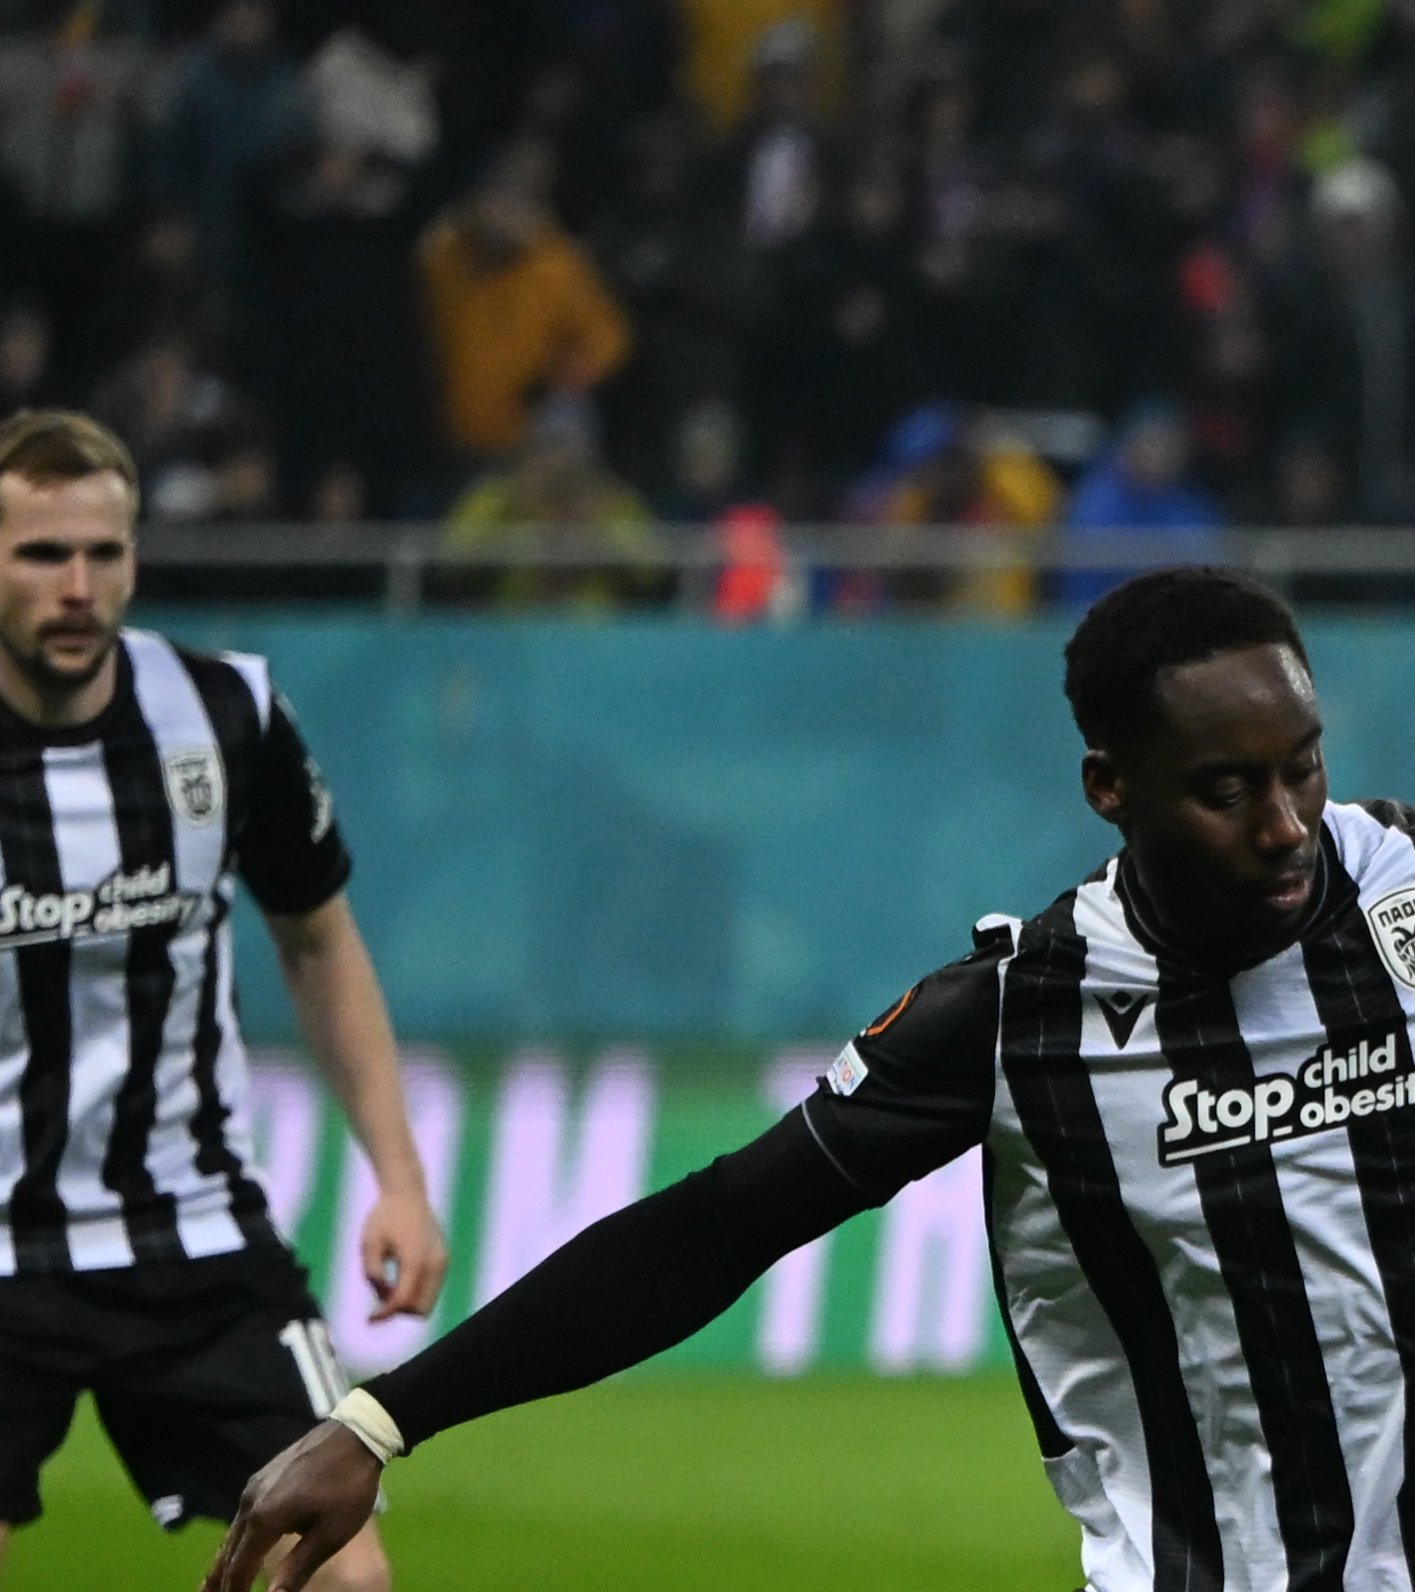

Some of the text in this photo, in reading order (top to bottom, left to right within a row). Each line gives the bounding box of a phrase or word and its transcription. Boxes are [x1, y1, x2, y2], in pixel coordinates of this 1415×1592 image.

[0, 884, 94, 938] Stop
[1303, 1033, 1397, 1089] child
[1164, 1078, 1295, 1143] Stop
